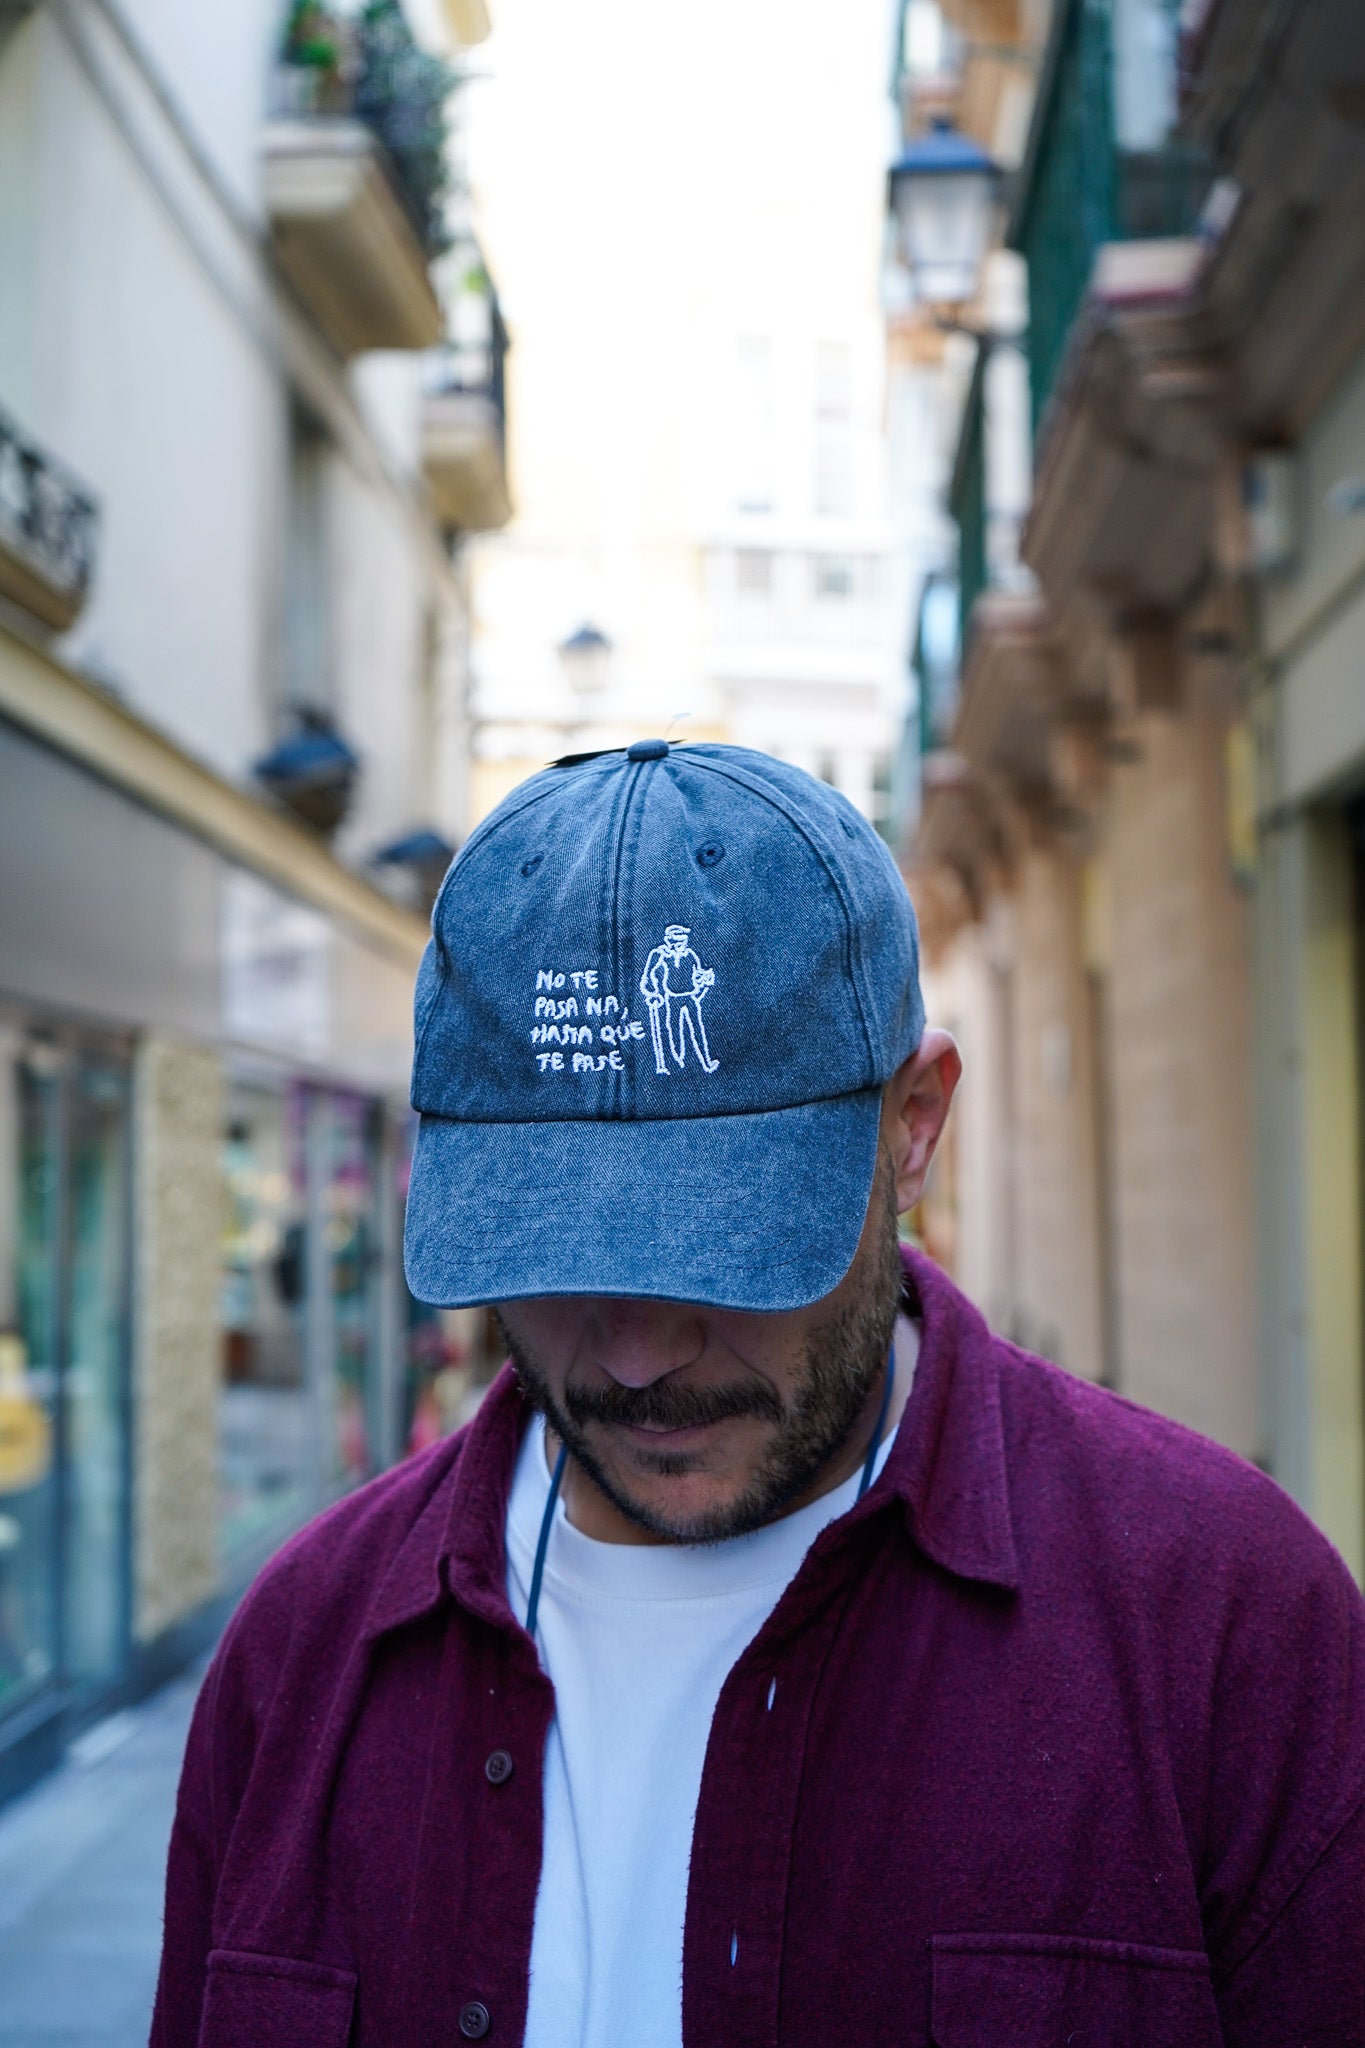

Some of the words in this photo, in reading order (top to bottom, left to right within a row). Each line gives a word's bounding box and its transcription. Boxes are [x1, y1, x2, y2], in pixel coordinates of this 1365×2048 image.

[535, 969, 566, 991] NO
[570, 970, 599, 990] TE
[534, 996, 579, 1020] PASA
[585, 995, 629, 1019] NA,
[530, 1023, 593, 1045] HASTA
[600, 1021, 646, 1045] QUE
[536, 1051, 565, 1072] TE
[572, 1050, 625, 1073] PASE
